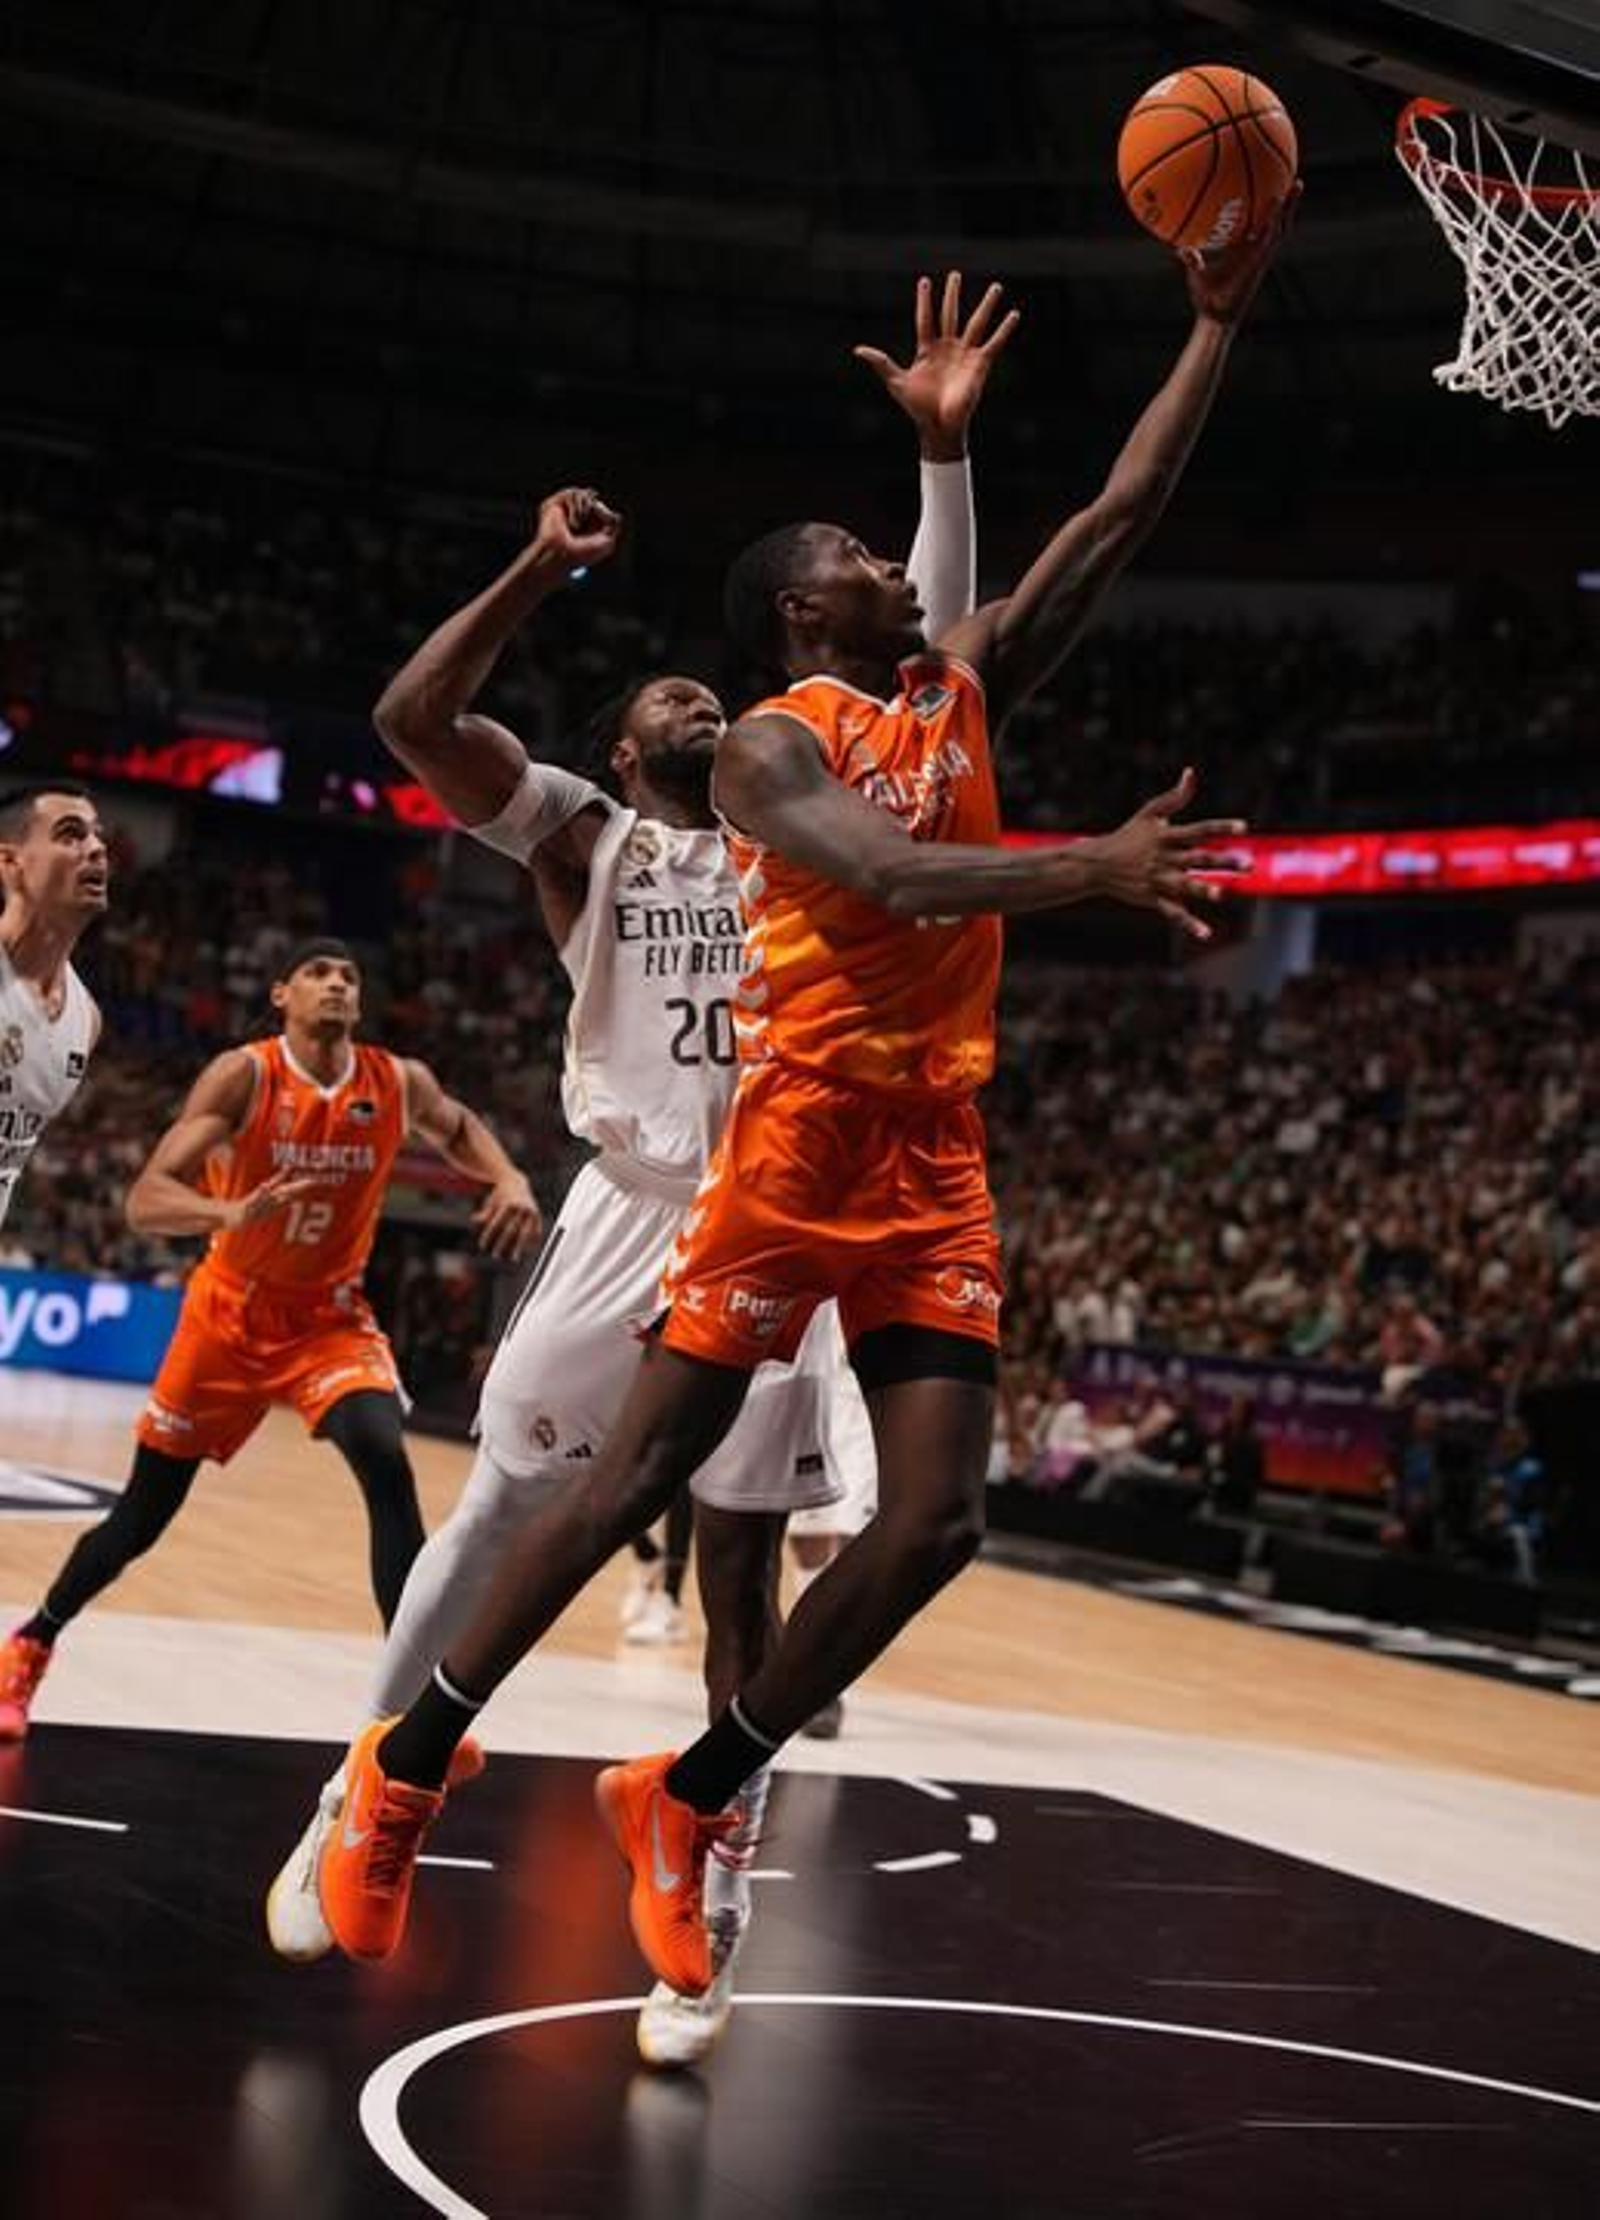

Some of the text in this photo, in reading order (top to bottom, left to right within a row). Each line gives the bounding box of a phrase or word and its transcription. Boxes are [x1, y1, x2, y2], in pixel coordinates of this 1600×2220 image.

[864, 740, 974, 806] VALCIA
[644, 945, 681, 977] FLY
[665, 998, 737, 1066] 20
[284, 1202, 333, 1244] 12
